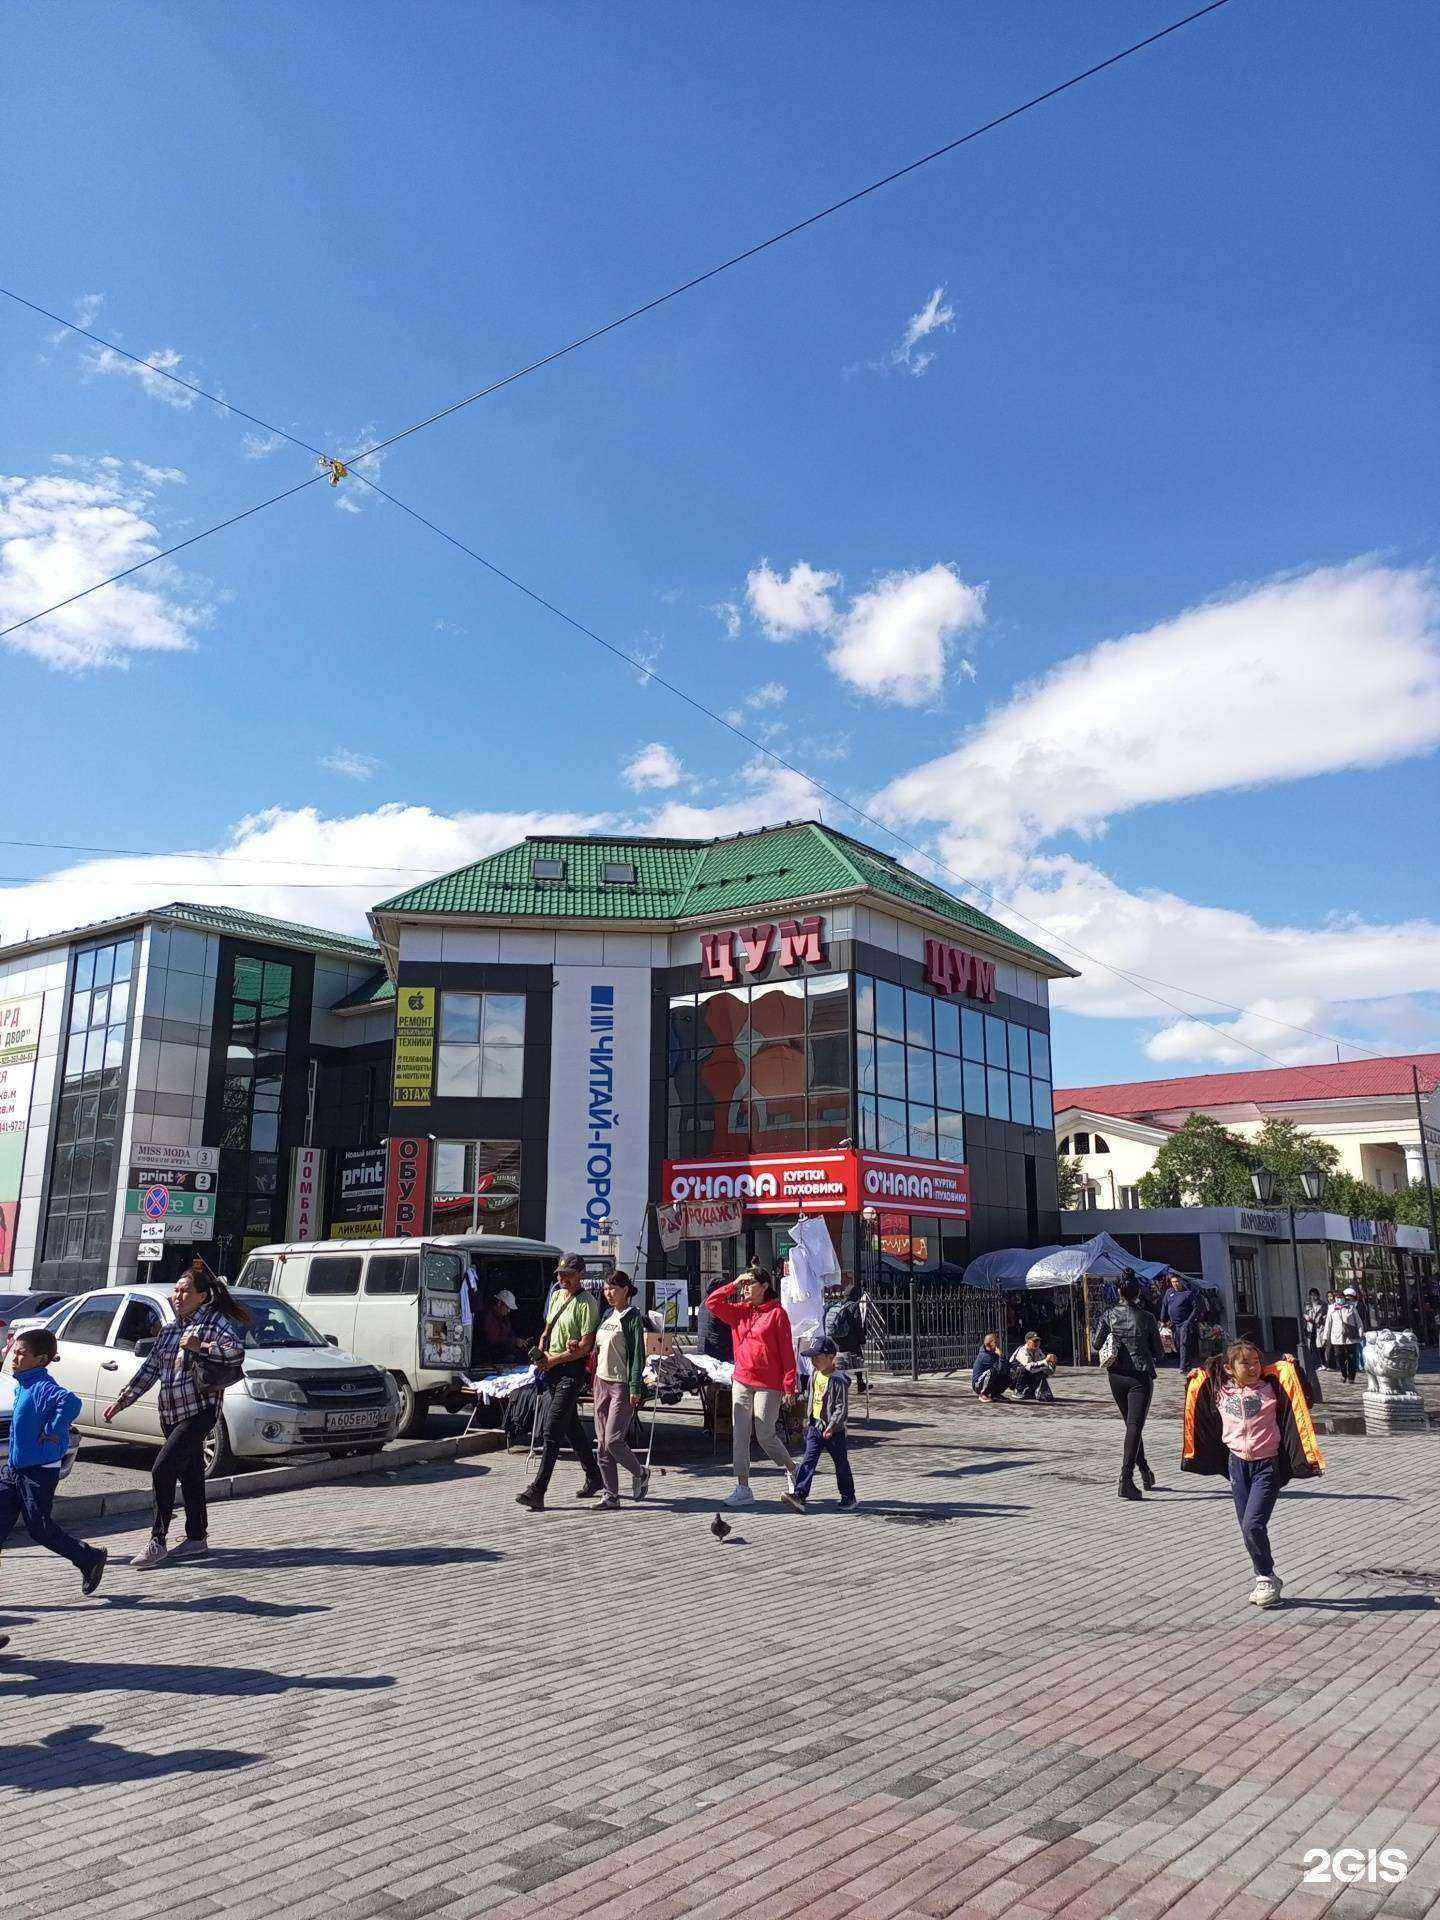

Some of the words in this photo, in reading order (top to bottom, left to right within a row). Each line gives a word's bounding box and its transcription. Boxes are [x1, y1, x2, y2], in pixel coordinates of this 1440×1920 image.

[701, 916, 824, 982] ЦУМ
[926, 939, 996, 1003] ЦУМ
[399, 1016, 432, 1026] РЕМОНТ
[399, 1038, 432, 1046] ТЕХНИКИ
[402, 1088, 430, 1100] ЭТАЖ
[580, 1036, 620, 1244] ЧИТАЙ-ГОРОД
[138, 1145, 161, 1155] MISS
[163, 1149, 190, 1158] MODA
[201, 1151, 207, 1161] 3
[139, 1170, 174, 1183] print
[200, 1175, 206, 1184] 2
[342, 1162, 383, 1190] print
[783, 1169, 826, 1181] КУРТКИ
[299, 1151, 314, 1240] ЛОМБАР
[395, 1140, 419, 1238] ОБУВЬ
[783, 1183, 845, 1195] ПУХОВИКИ
